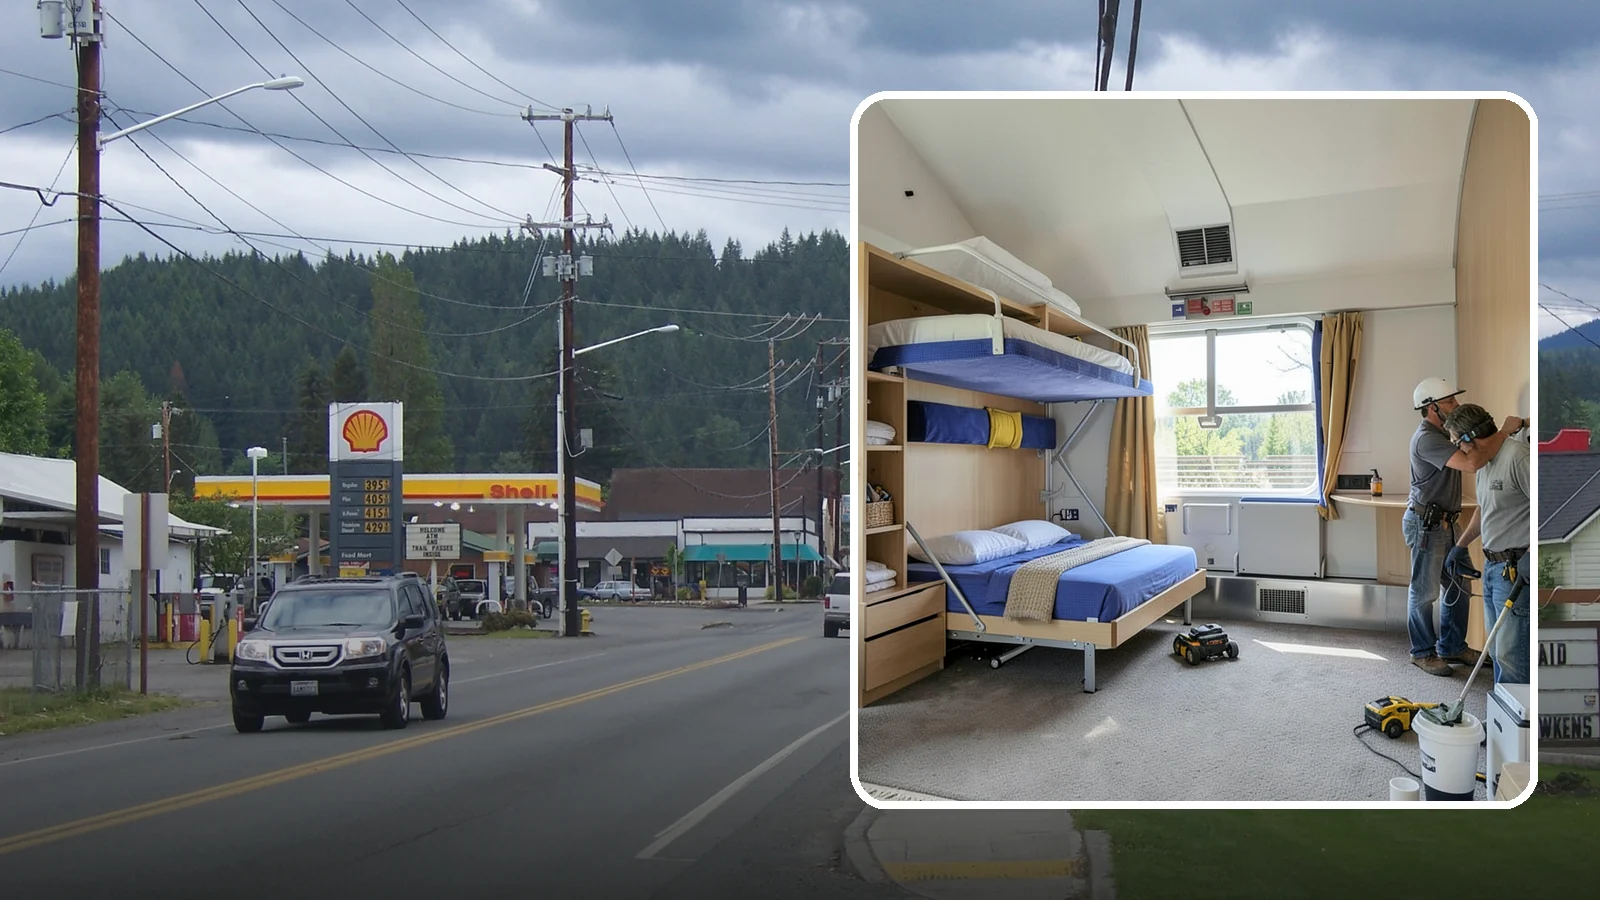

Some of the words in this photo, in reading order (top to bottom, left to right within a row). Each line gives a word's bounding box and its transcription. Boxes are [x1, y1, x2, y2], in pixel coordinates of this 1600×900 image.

[365, 480, 383, 490] 395
[490, 484, 547, 499] Shell
[365, 494, 383, 504] 405
[365, 508, 383, 518] 415
[365, 522, 383, 533] 429
